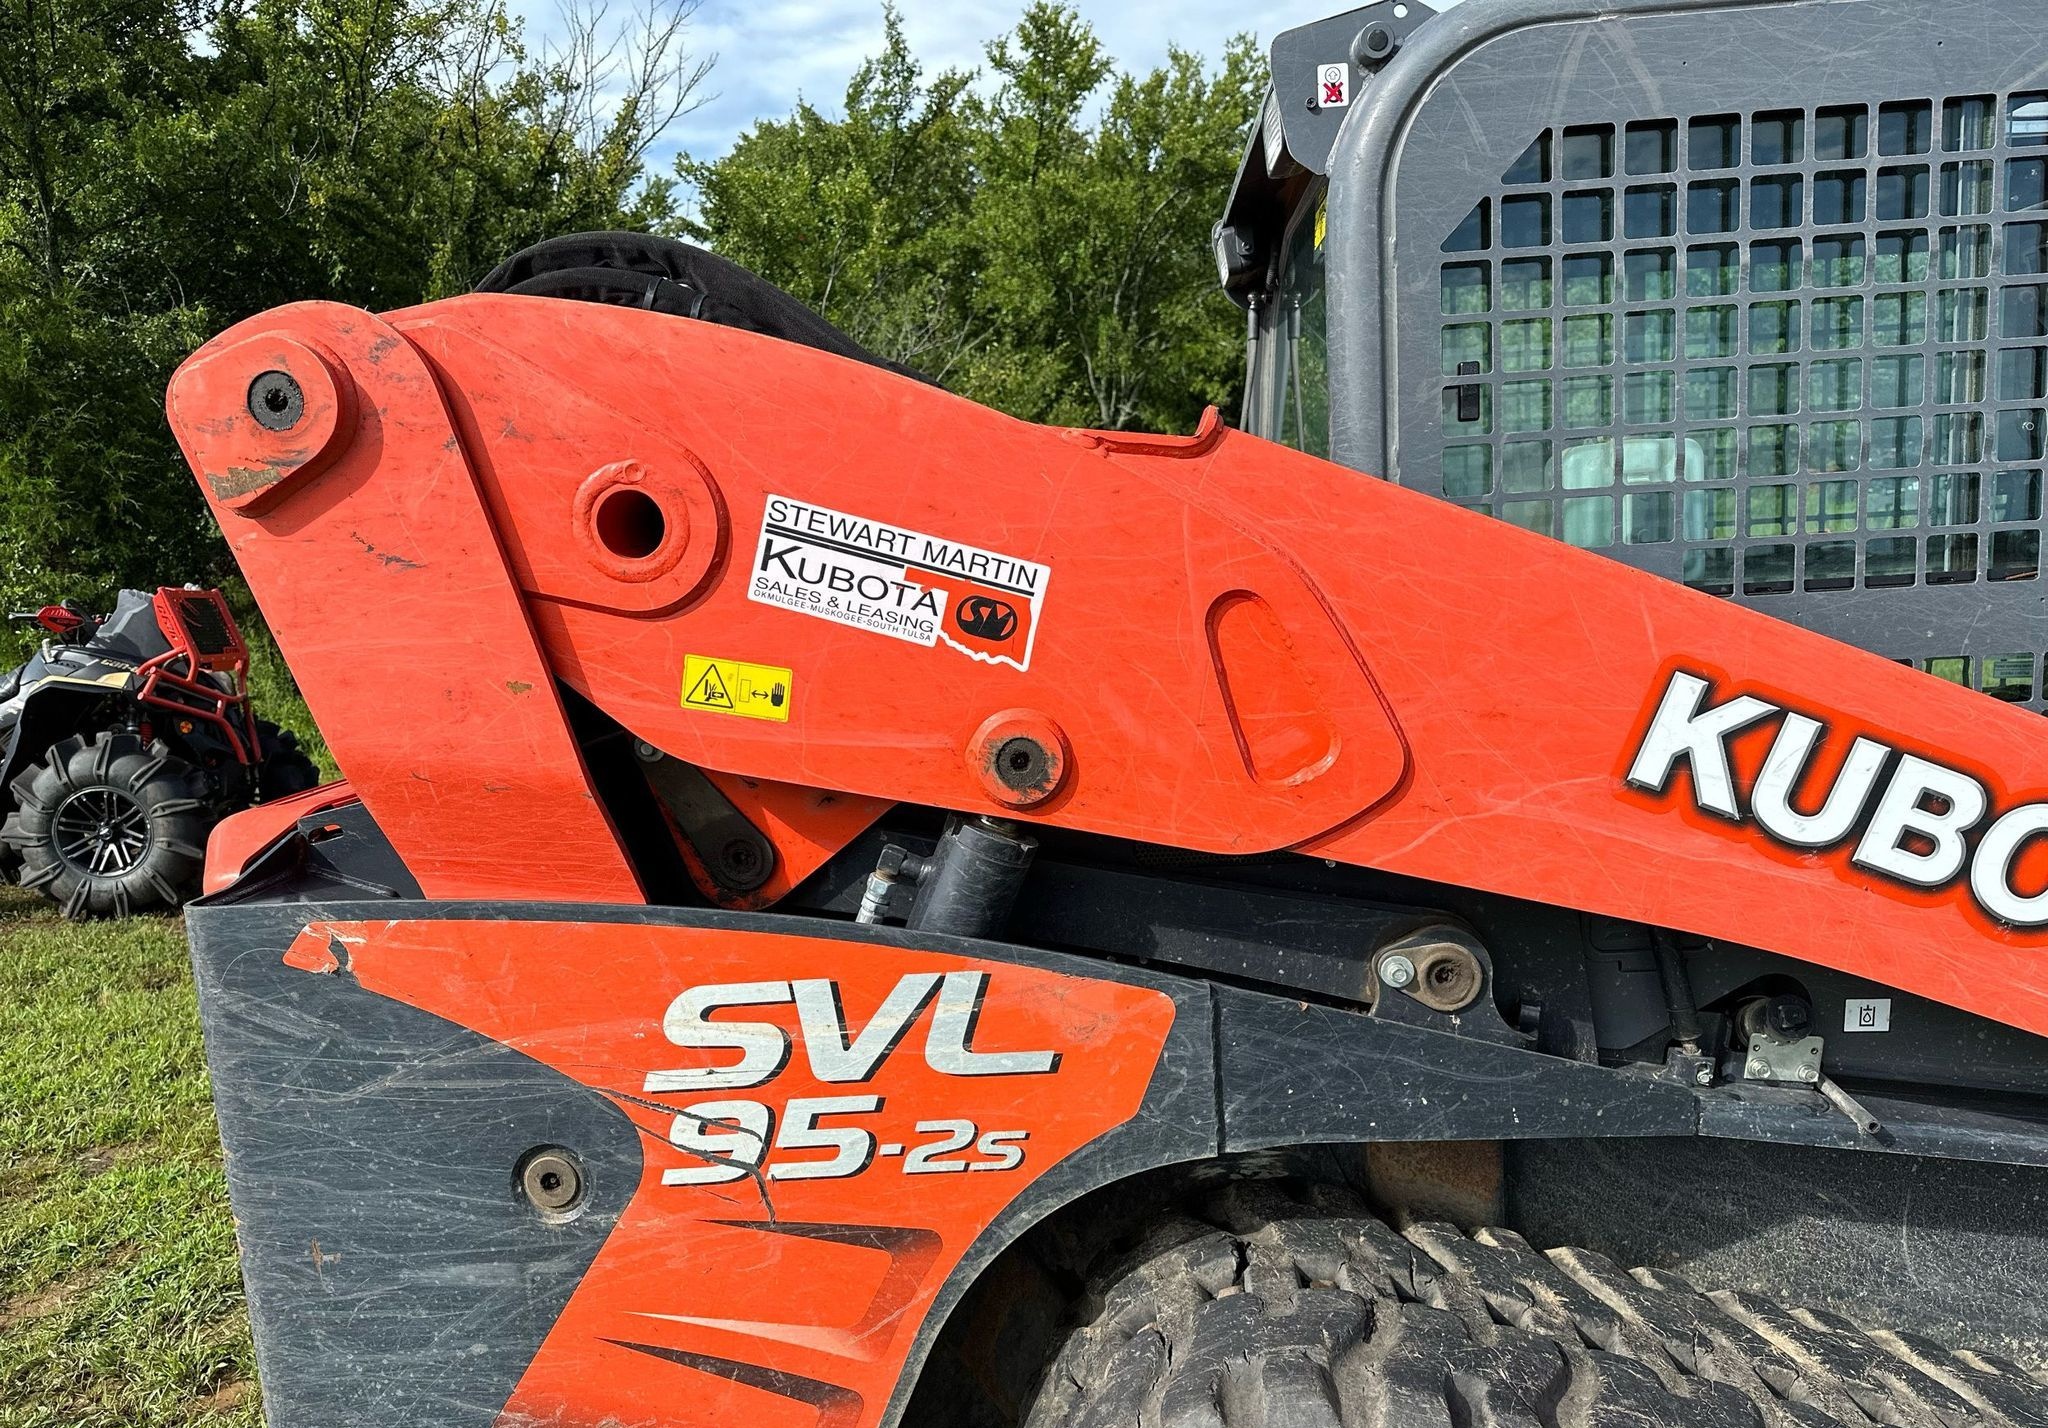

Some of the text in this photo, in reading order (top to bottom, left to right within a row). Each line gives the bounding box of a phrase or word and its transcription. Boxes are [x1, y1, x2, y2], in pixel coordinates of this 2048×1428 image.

[760, 538, 939, 616] KUBOTA
[768, 500, 1038, 589] STEWART MARTIN
[753, 589, 931, 642] OKMULGEE-MUSKOGEE-SOUTH TULSA
[755, 577, 934, 634] SALES & LEASING
[642, 970, 1062, 1093] SVL
